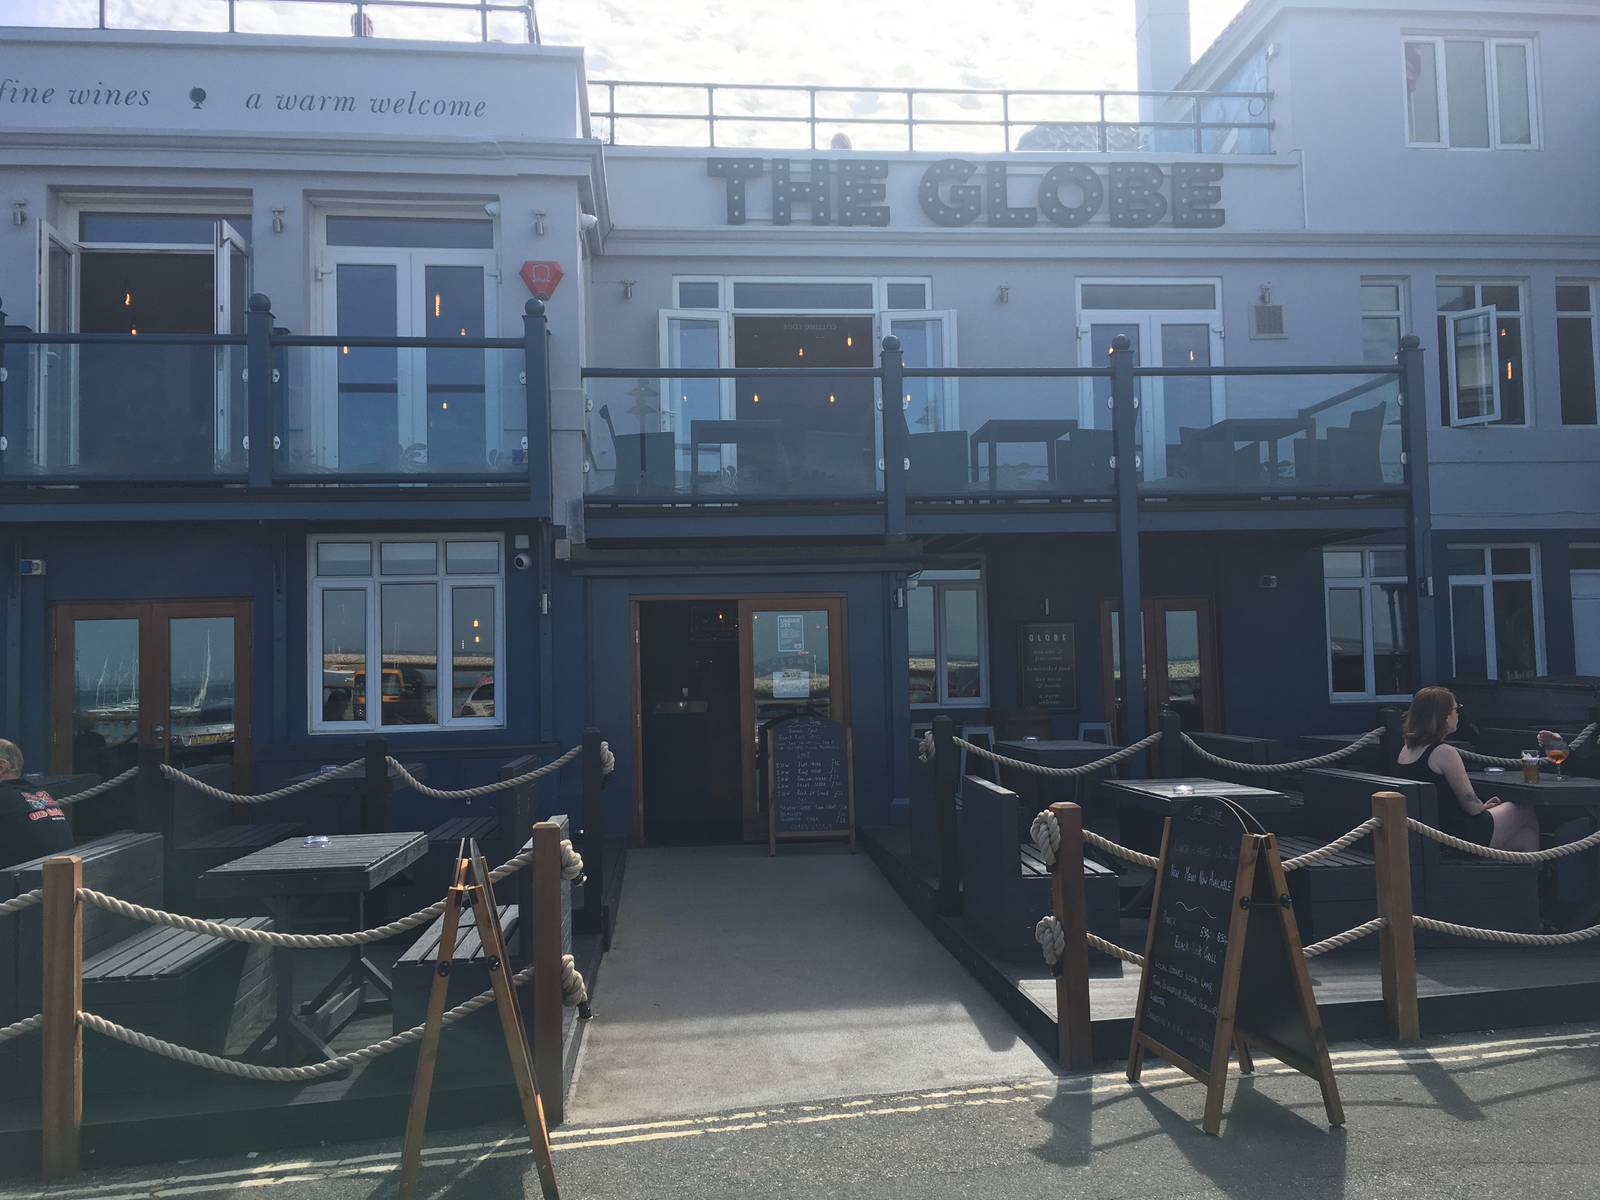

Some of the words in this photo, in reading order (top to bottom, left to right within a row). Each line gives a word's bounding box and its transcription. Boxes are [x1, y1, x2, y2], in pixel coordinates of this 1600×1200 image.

[0, 78, 55, 104] fine
[68, 81, 151, 106] wines
[245, 93, 262, 110] a
[275, 94, 356, 112] warm
[369, 90, 486, 118] welcome
[707, 157, 891, 227] THE
[918, 158, 1226, 229] GLOBE
